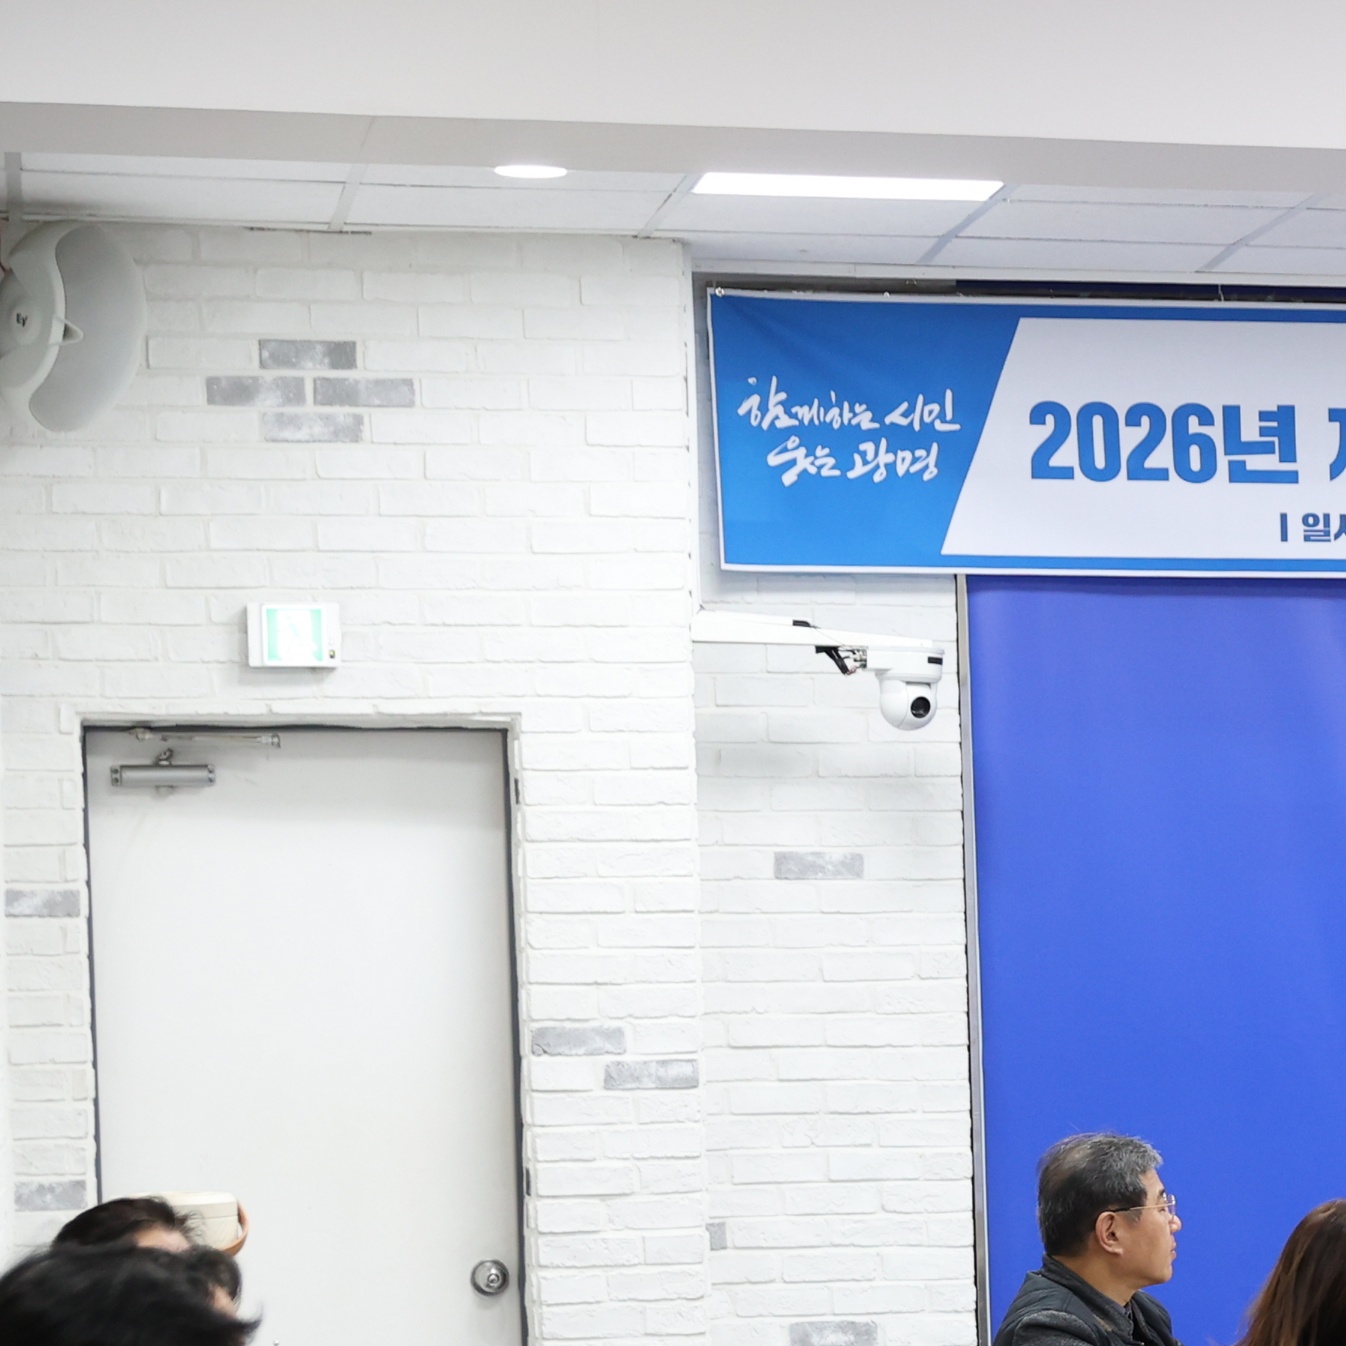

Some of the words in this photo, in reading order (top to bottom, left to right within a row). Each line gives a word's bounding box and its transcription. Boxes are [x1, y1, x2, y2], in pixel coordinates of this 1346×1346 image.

[738, 377, 879, 429] 함께하는
[885, 390, 960, 431] 시민
[1030, 401, 1299, 484] 2026년
